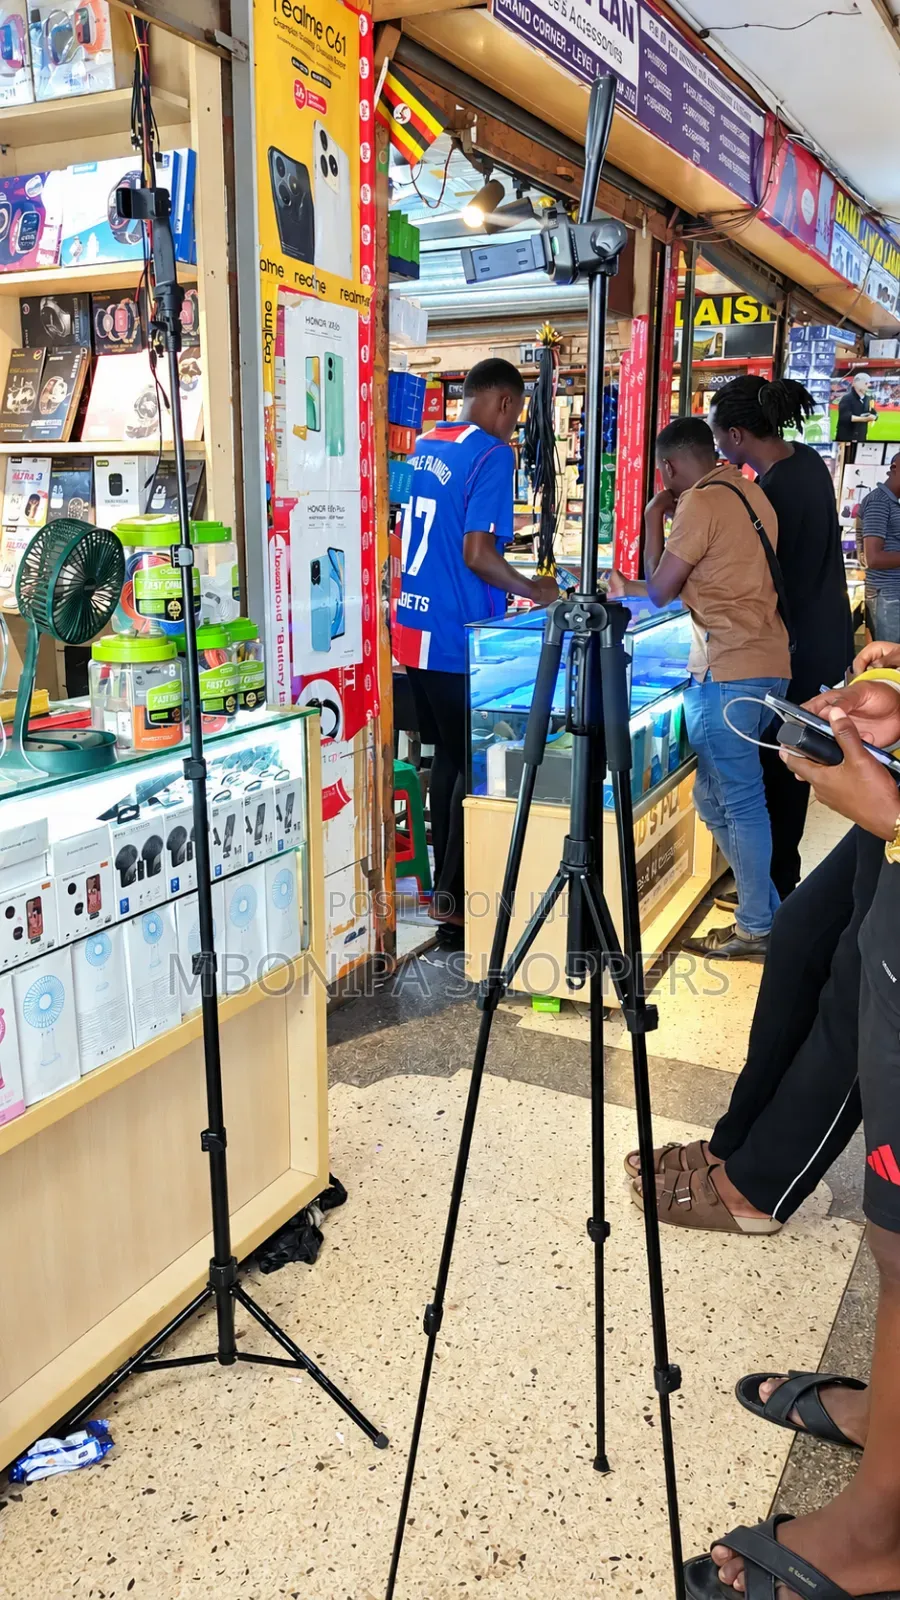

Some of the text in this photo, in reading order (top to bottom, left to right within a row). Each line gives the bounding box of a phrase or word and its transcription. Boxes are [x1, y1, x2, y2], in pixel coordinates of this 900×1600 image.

[325, 25, 347, 57] C61
[532, 14, 568, 54] CORNER
[572, 44, 595, 76] LEVEL
[305, 316, 327, 328] HONOR
[307, 504, 326, 513] HONOR
[400, 496, 437, 578] 17
